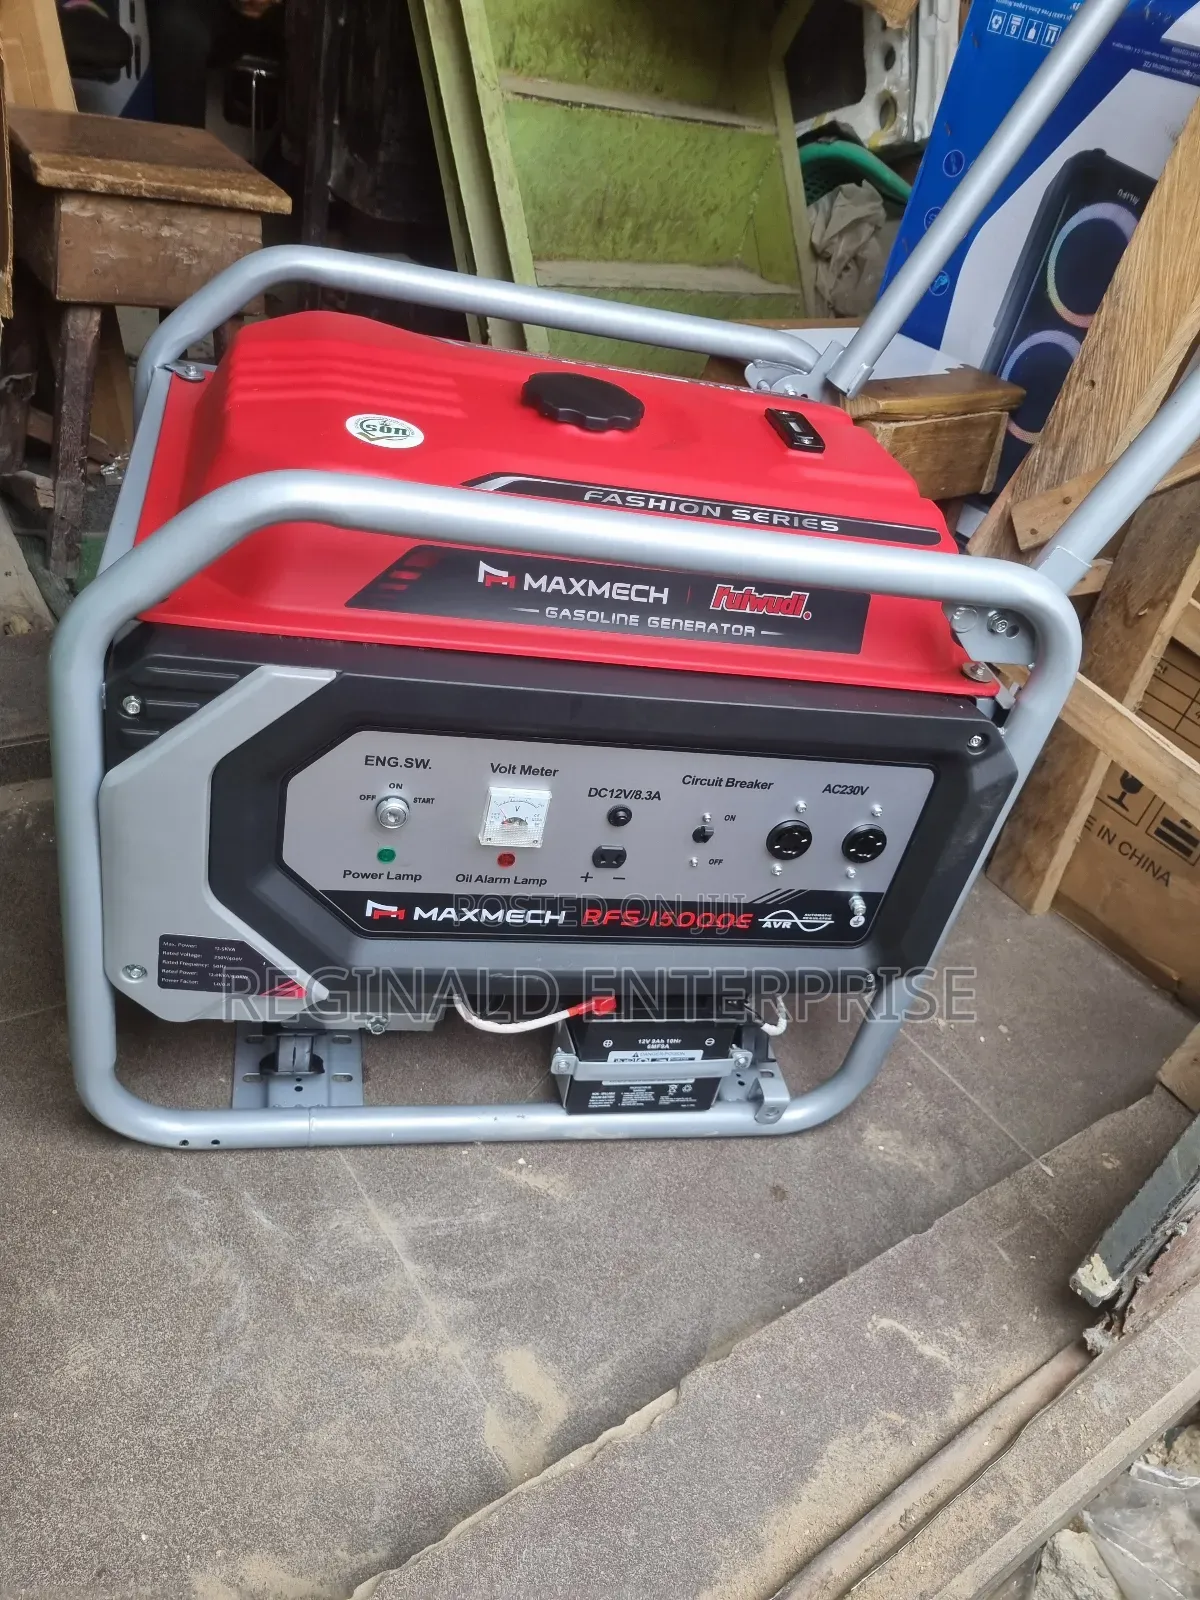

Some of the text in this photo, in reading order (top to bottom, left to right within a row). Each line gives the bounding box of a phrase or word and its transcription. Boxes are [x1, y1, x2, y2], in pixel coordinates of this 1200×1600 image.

[584, 490, 840, 532] FASHION SERIES
[523, 572, 669, 605] MAXMECH
[545, 606, 756, 638] GASOLINE GENERATOR
[364, 755, 433, 770] ENG.SW.
[490, 763, 559, 777] Volt Meter
[681, 774, 774, 791] Circuit Breaker
[822, 783, 870, 796] AC230V
[413, 797, 435, 805] START
[588, 787, 662, 802] DC12V/8.3A
[724, 814, 737, 822] ON
[708, 858, 724, 866] OFF
[1097, 825, 1170, 887] IN CHINA
[342, 869, 423, 883] Power Lamp
[455, 873, 547, 888] Oil Alarm Lamp
[413, 907, 565, 925] MAXMECH
[762, 921, 792, 929] AVR
